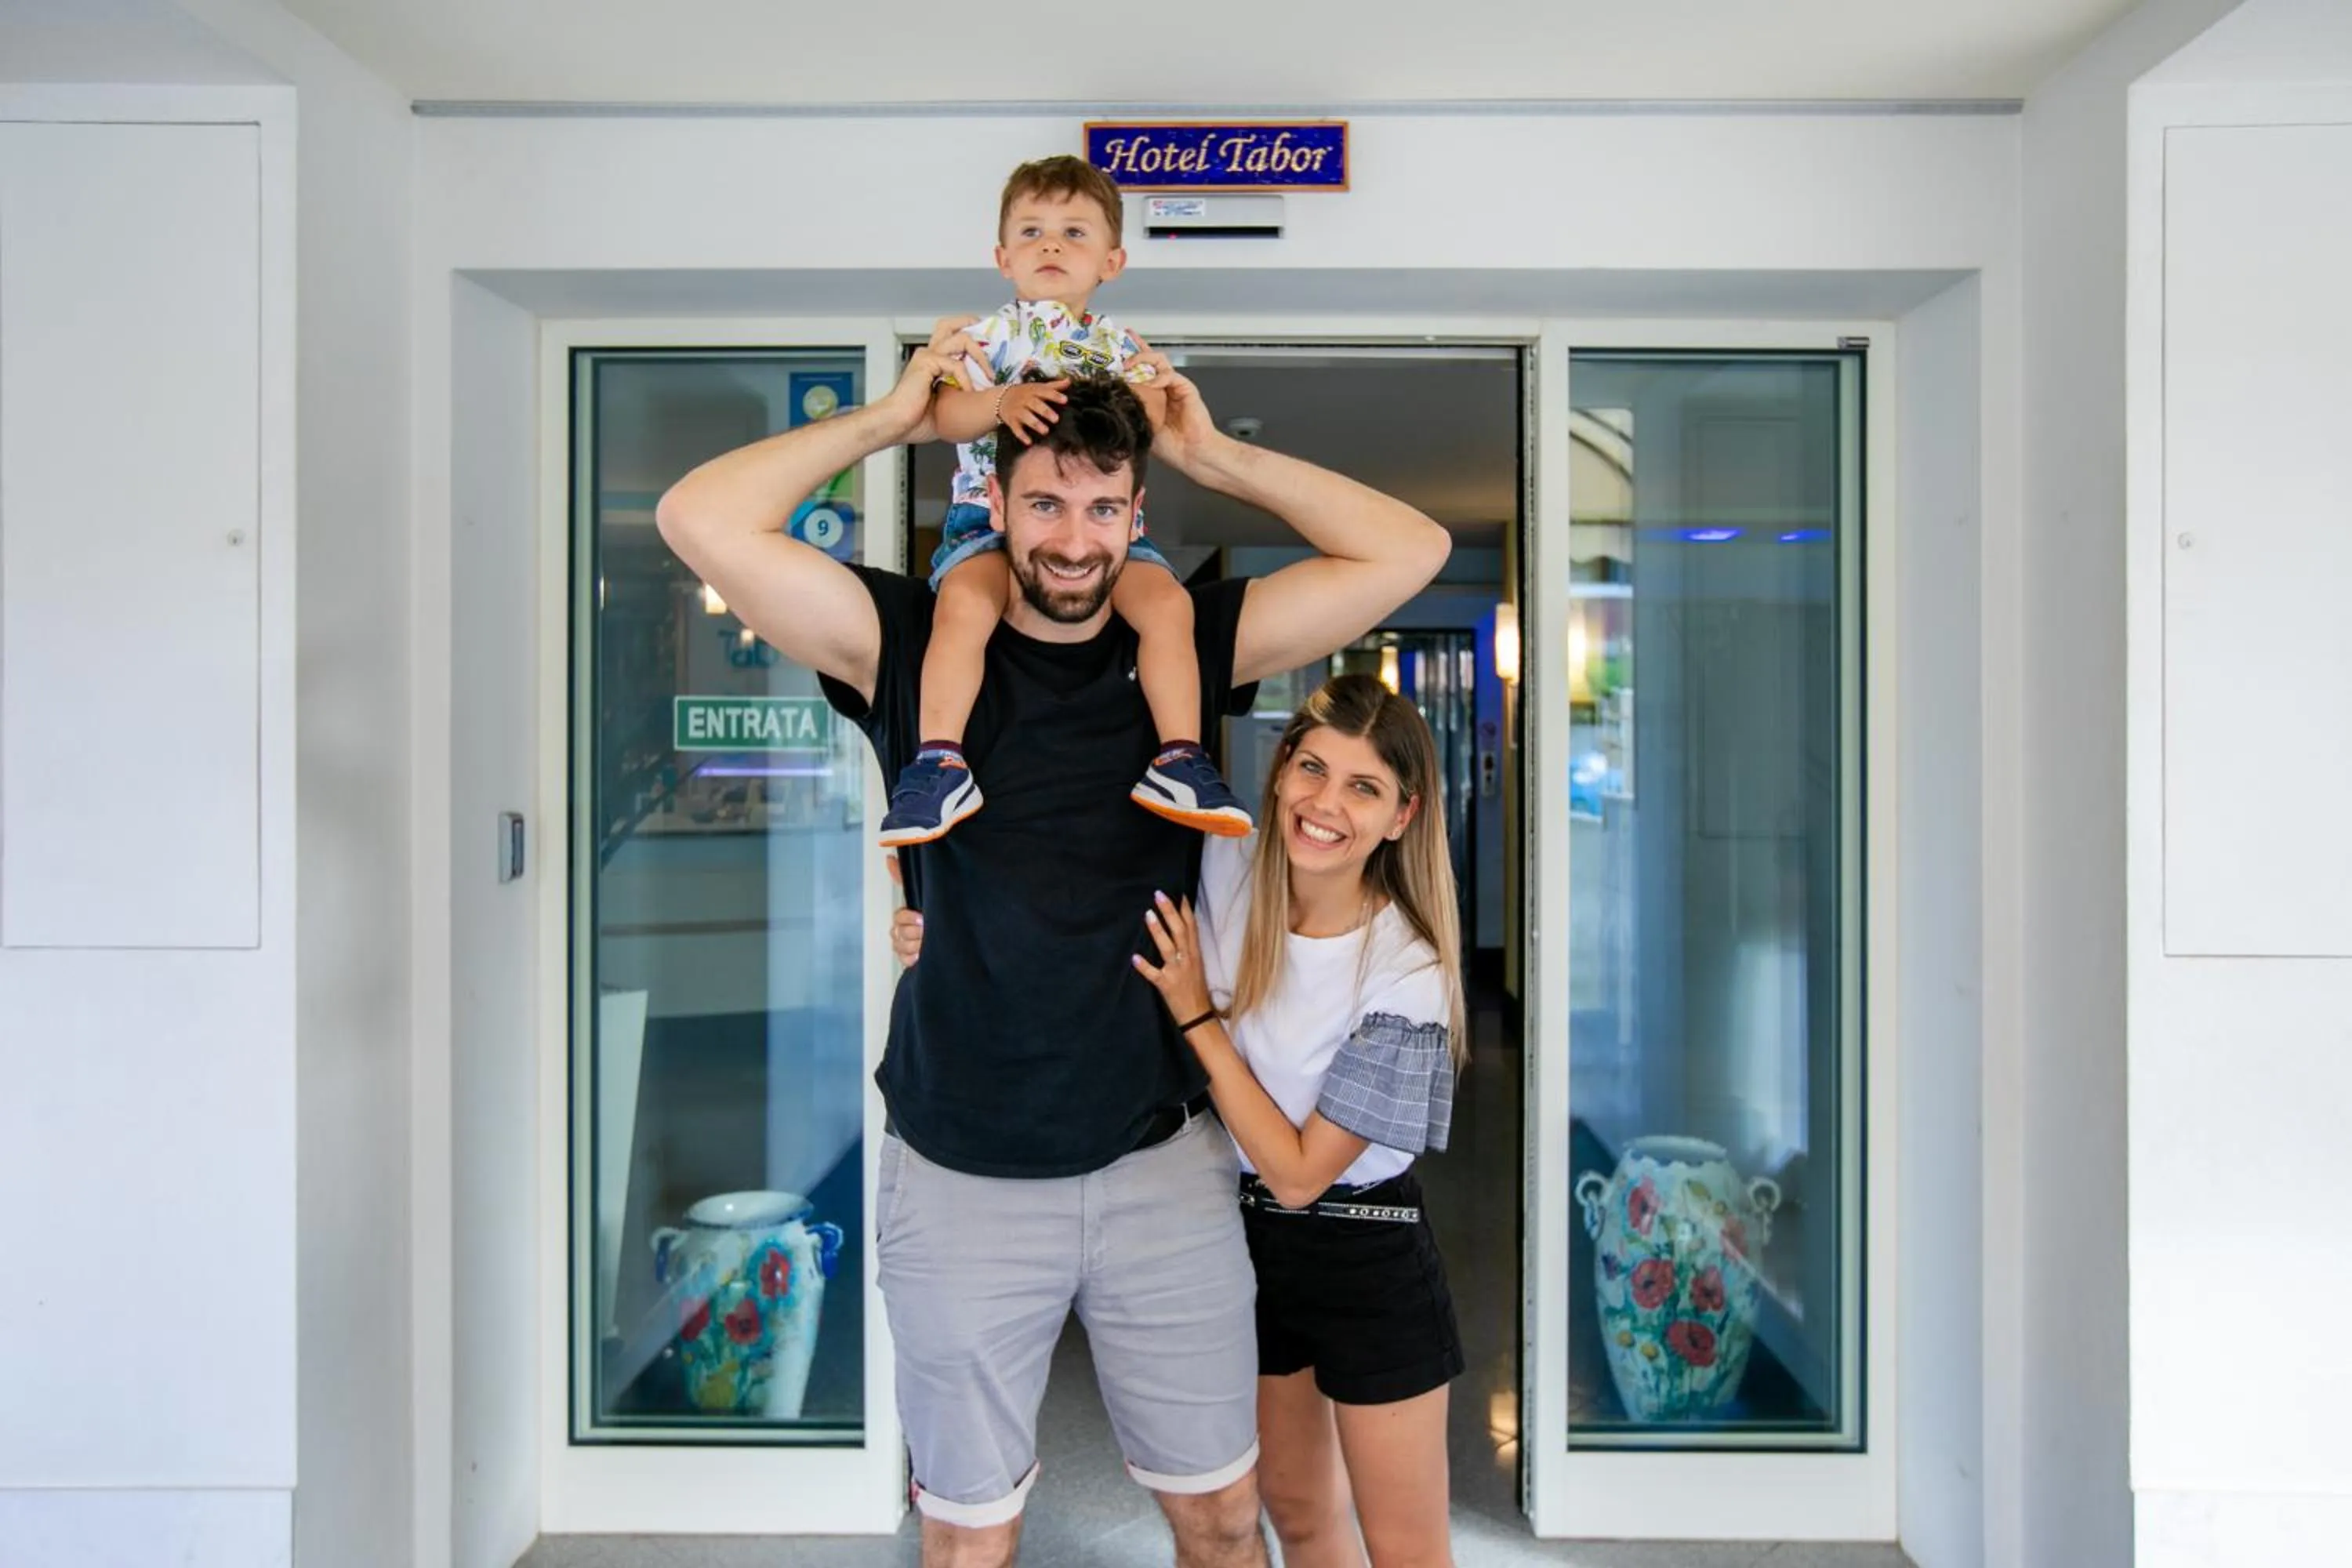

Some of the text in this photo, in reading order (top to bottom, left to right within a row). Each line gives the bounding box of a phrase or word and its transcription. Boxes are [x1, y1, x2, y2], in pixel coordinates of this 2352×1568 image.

[1102, 132, 1333, 173] Hotel Tabor
[818, 519, 829, 536] 9
[717, 629, 779, 669] Tab
[688, 707, 818, 739] ENTRATA
